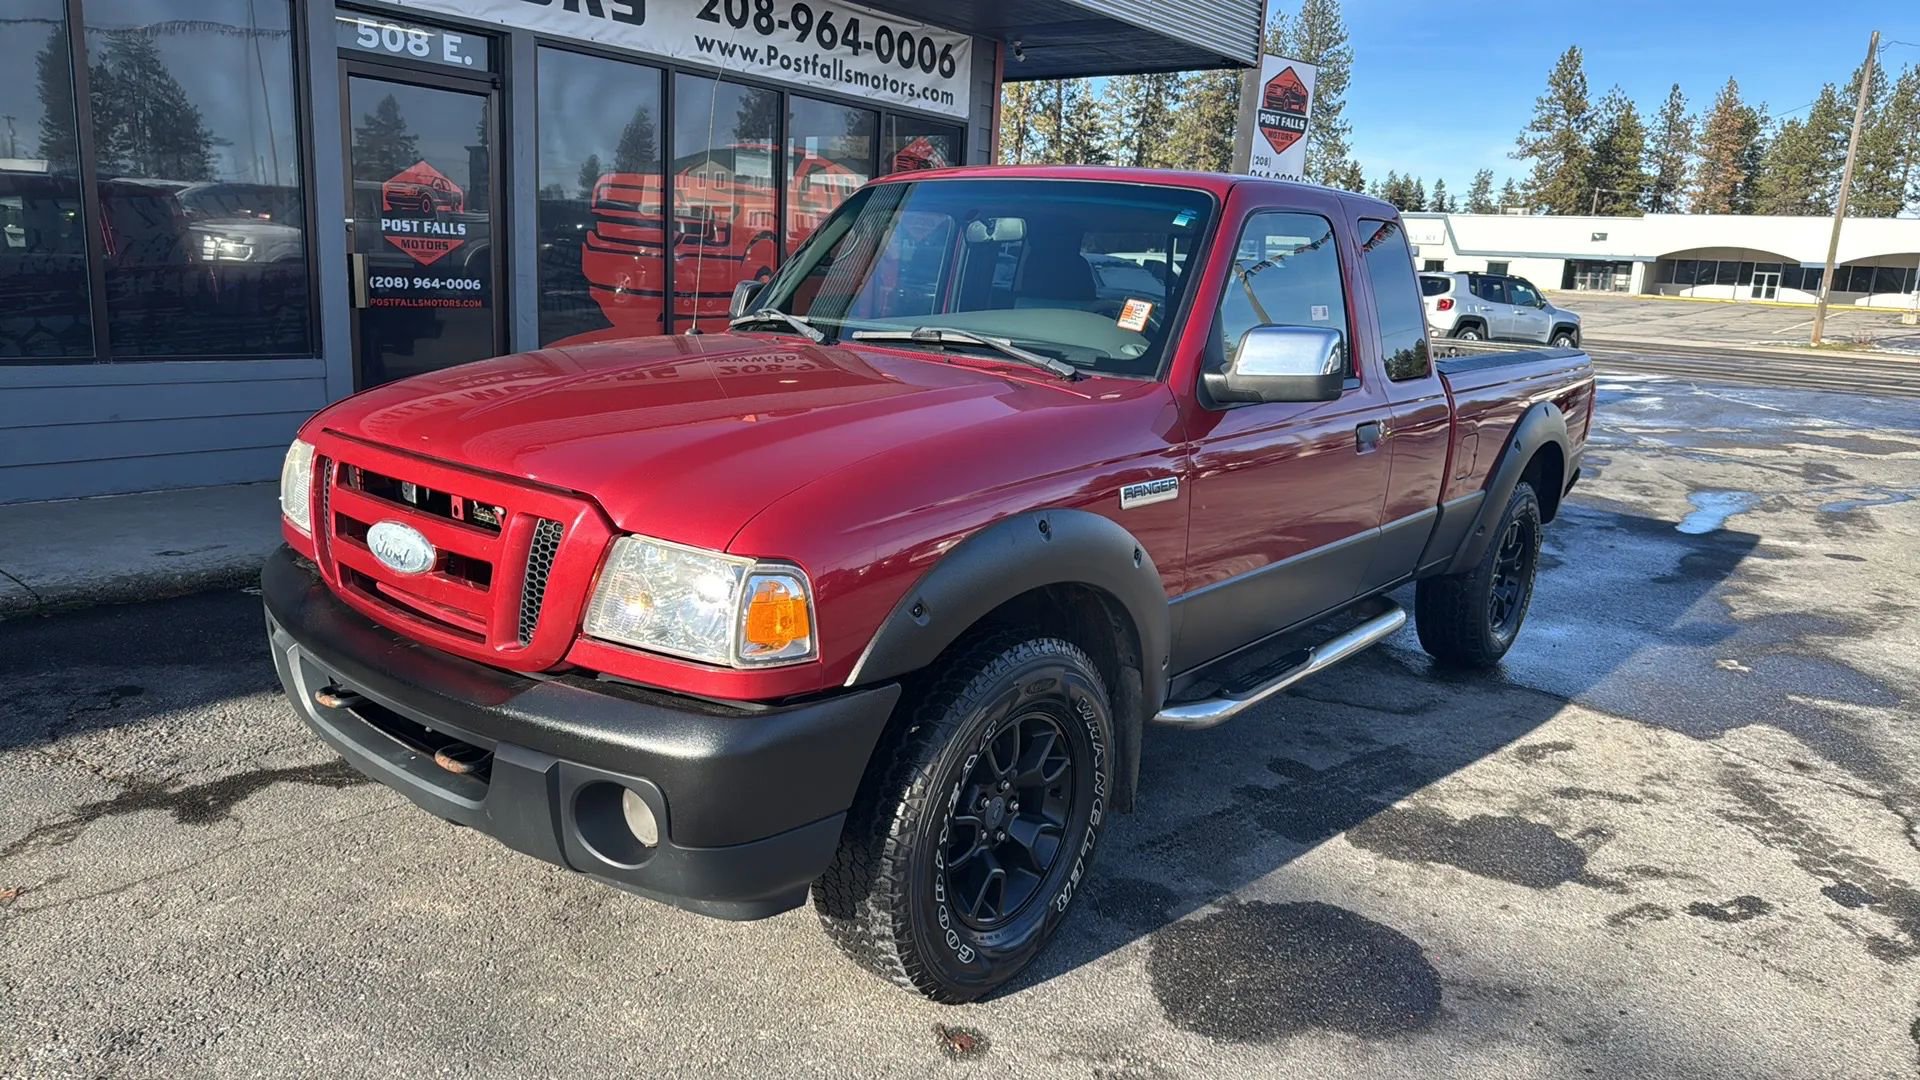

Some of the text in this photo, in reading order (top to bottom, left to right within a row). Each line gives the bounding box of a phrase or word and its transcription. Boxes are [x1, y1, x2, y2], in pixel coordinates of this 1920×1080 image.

[357, 17, 473, 66] 508 E.
[696, 0, 956, 79] 208-964-0006
[695, 35, 954, 106] www.Postfallsmotors.com
[1260, 113, 1305, 130] POST FALLS
[1267, 130, 1293, 141] MOTORS
[1252, 155, 1271, 168] (208)
[381, 218, 466, 235] POST FALLS
[400, 239, 449, 251] MOTORS
[369, 276, 481, 290] (208) 964-0006
[370, 298, 482, 308] POSTFALLSMOTORS.COM
[1123, 478, 1178, 500] RANGER
[1057, 696, 1106, 912] WRANGLER
